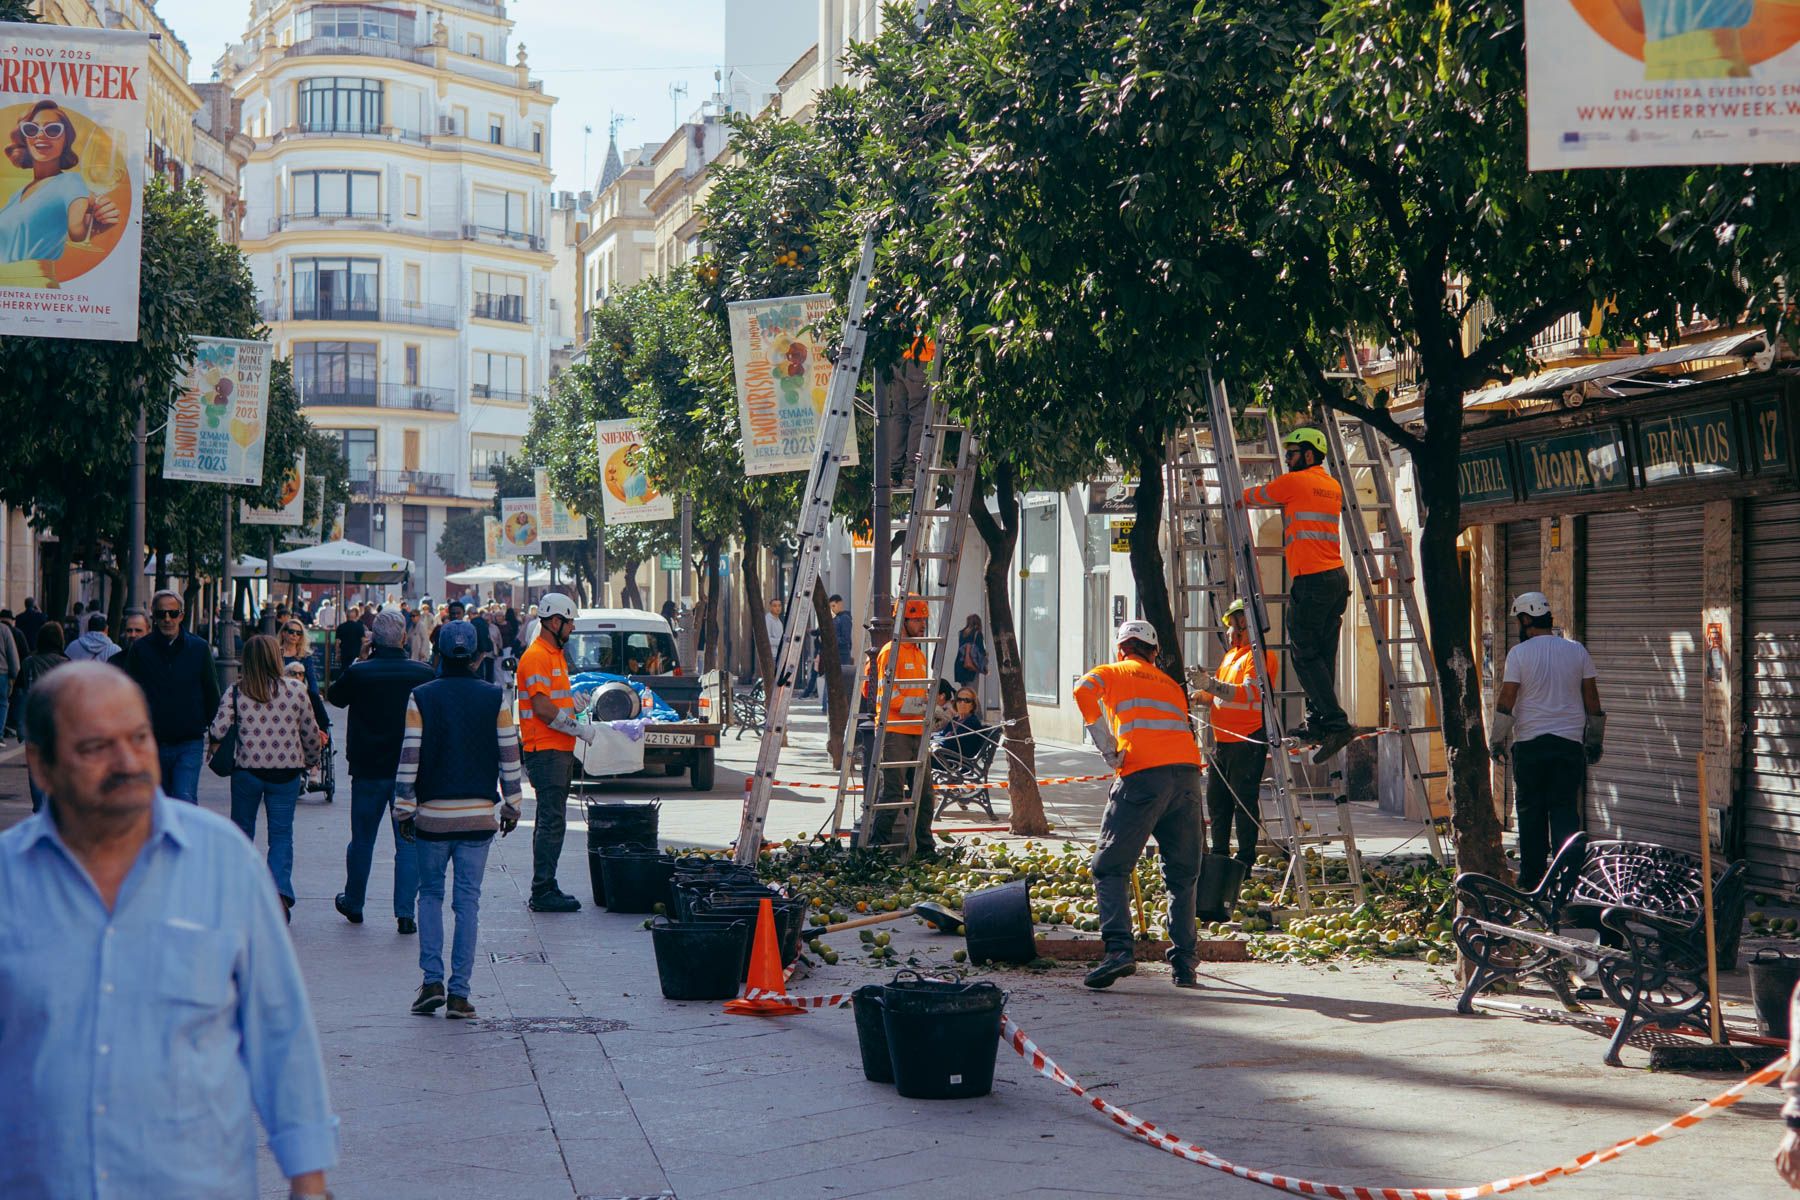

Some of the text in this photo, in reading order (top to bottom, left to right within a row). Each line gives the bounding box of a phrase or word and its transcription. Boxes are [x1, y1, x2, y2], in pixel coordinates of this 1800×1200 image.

[25, 47, 54, 57] NOV
[60, 50, 91, 60] 2025
[0, 58, 140, 100] RRYWEEK
[1614, 87, 1702, 100] ENCUENTRA
[1708, 85, 1777, 98] EVENTOS
[35, 292, 75, 301] EVENTOS
[239, 355, 263, 365] WINE
[238, 371, 262, 383] DAY
[235, 406, 259, 419] 2025
[778, 408, 814, 419] SEMANA
[199, 431, 230, 442] SEMANA
[1647, 420, 1731, 467] REGALOS
[1760, 409, 1778, 462] 17
[754, 435, 817, 458] JEREZ 2025
[198, 454, 228, 471] 2025
[645, 734, 692, 745] 4216 KZM
